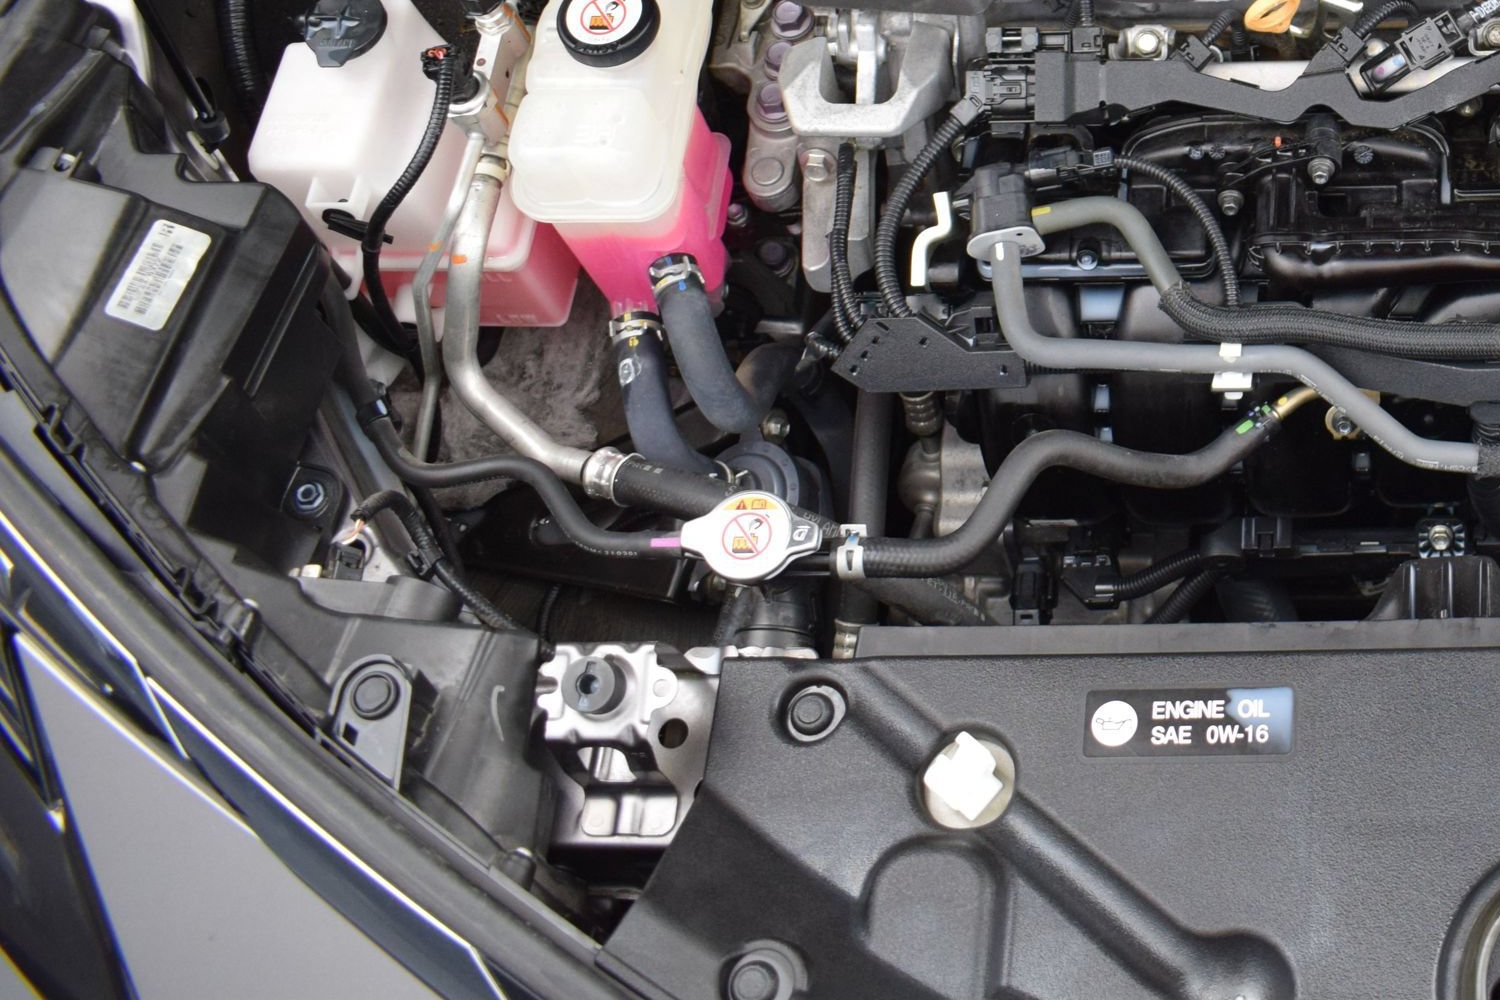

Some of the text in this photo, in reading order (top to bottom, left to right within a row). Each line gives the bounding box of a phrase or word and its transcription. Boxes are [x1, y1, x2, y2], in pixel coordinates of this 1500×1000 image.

[1151, 698, 1270, 720] ENGINE OIL
[1151, 724, 1269, 745] SAE 0W-16
